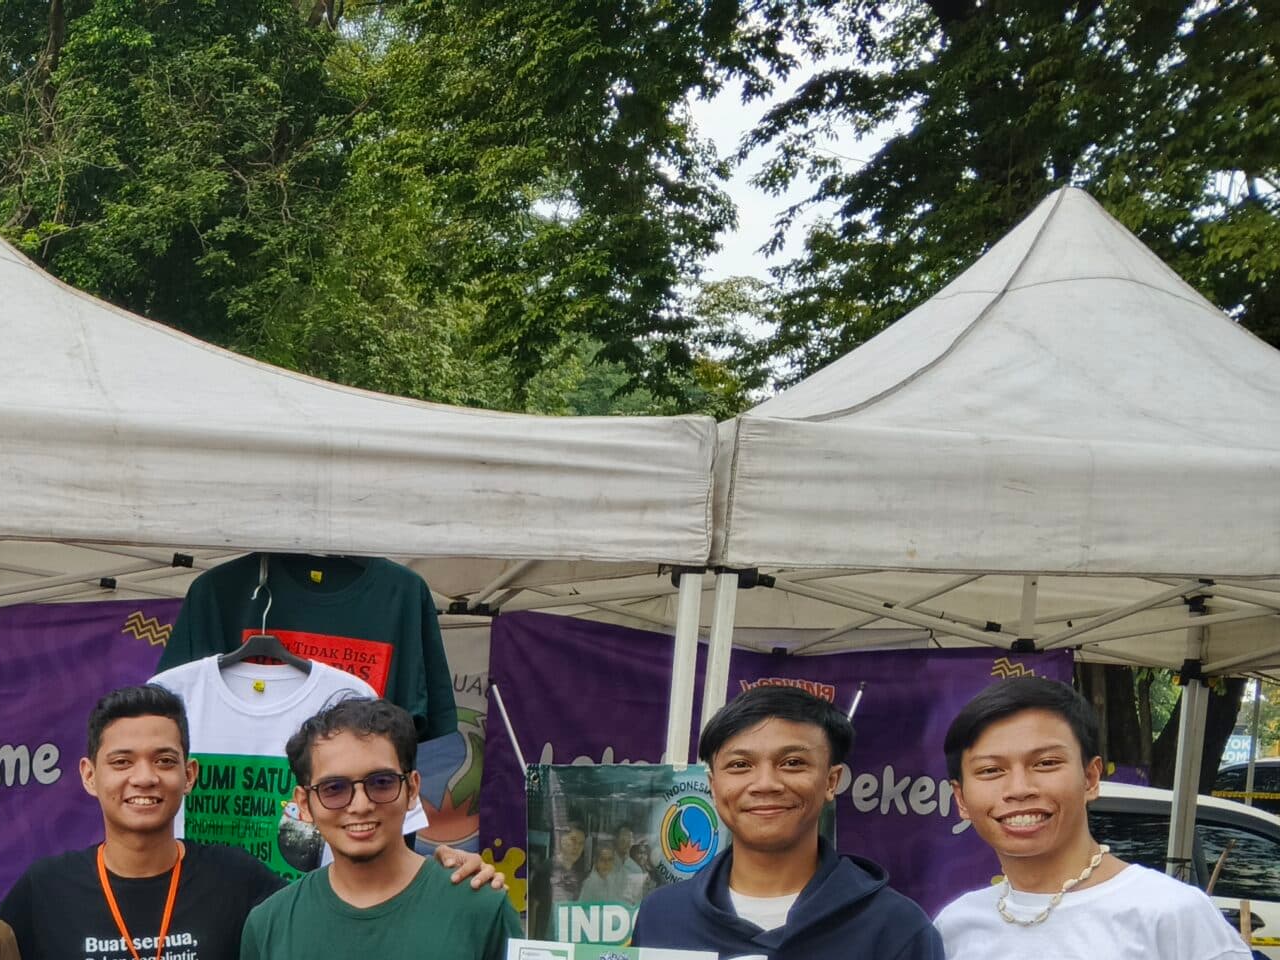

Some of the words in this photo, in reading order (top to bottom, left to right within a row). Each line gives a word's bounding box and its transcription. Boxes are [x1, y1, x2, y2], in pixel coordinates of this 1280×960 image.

[193, 764, 236, 791] UMI
[242, 766, 293, 796] SATU
[185, 794, 230, 815] UNTUK
[234, 795, 277, 817] SEMUA
[557, 904, 636, 945] IND
[85, 936, 128, 953] Buat
